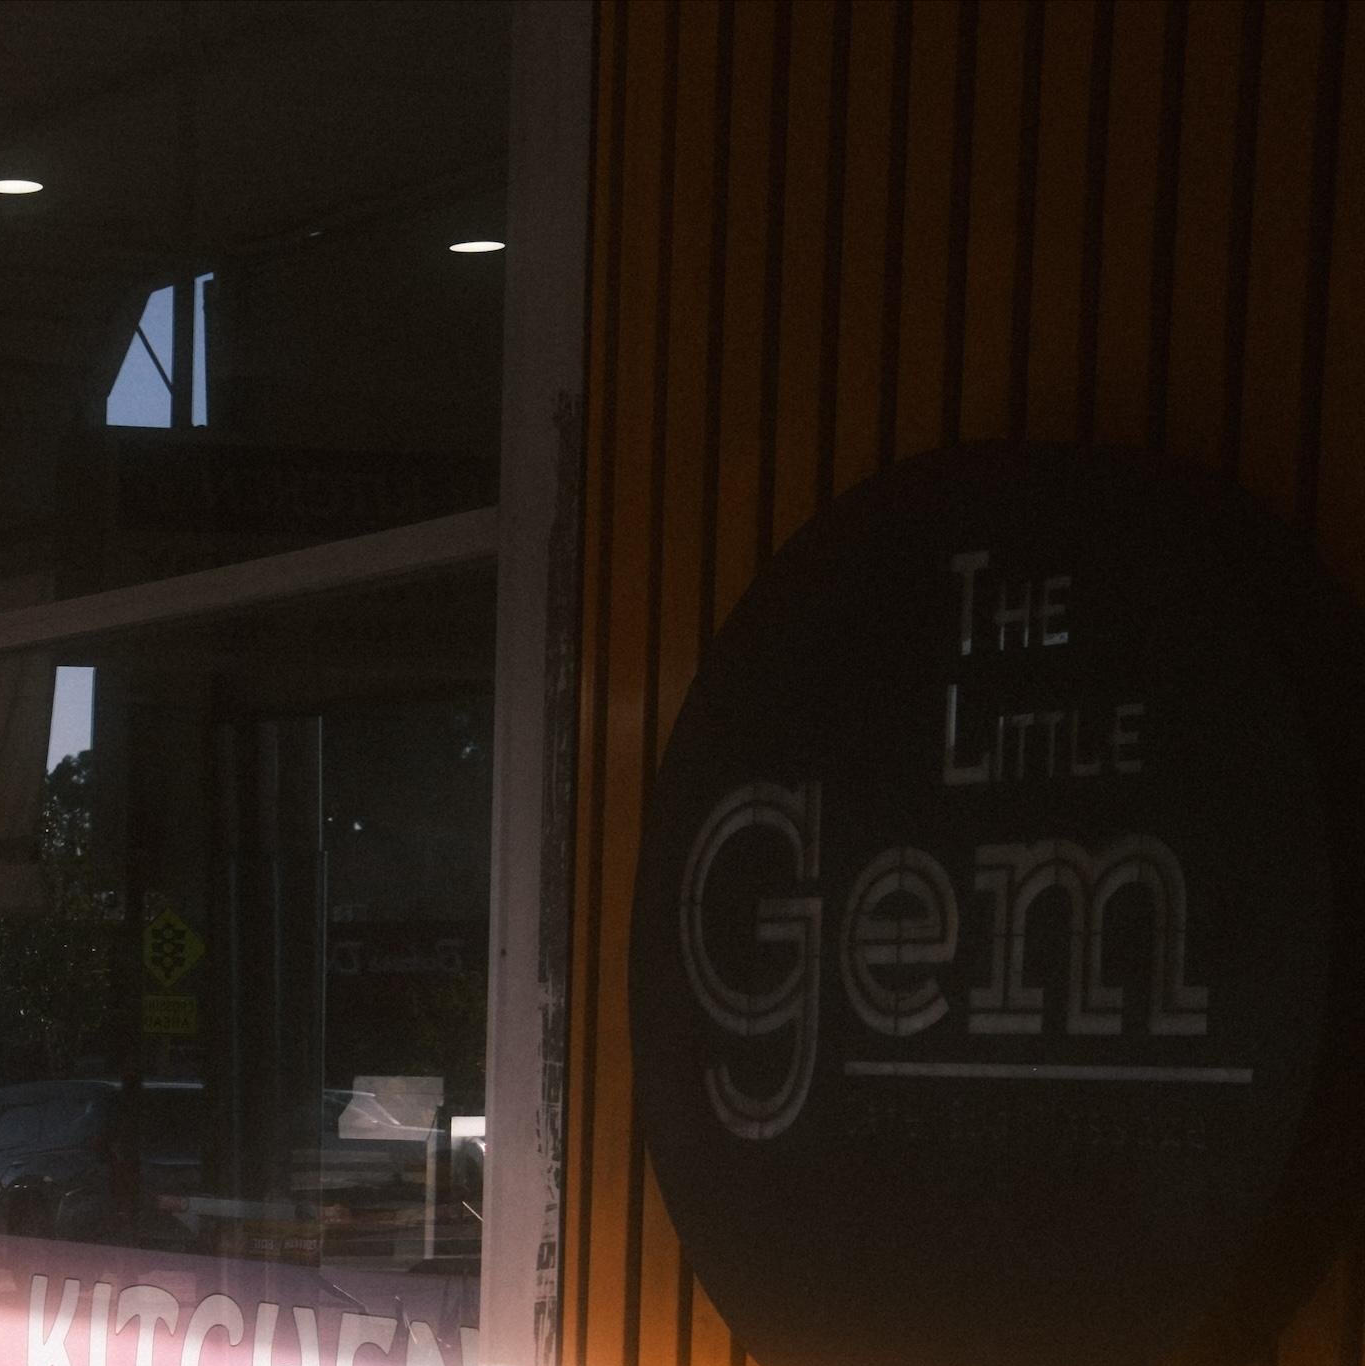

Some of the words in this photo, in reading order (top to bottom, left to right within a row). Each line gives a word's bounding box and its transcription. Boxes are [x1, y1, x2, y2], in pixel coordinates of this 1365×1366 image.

[950, 550, 1070, 656] THE
[944, 684, 1146, 786] LITTLE
[679, 781, 1209, 1140] Gem
